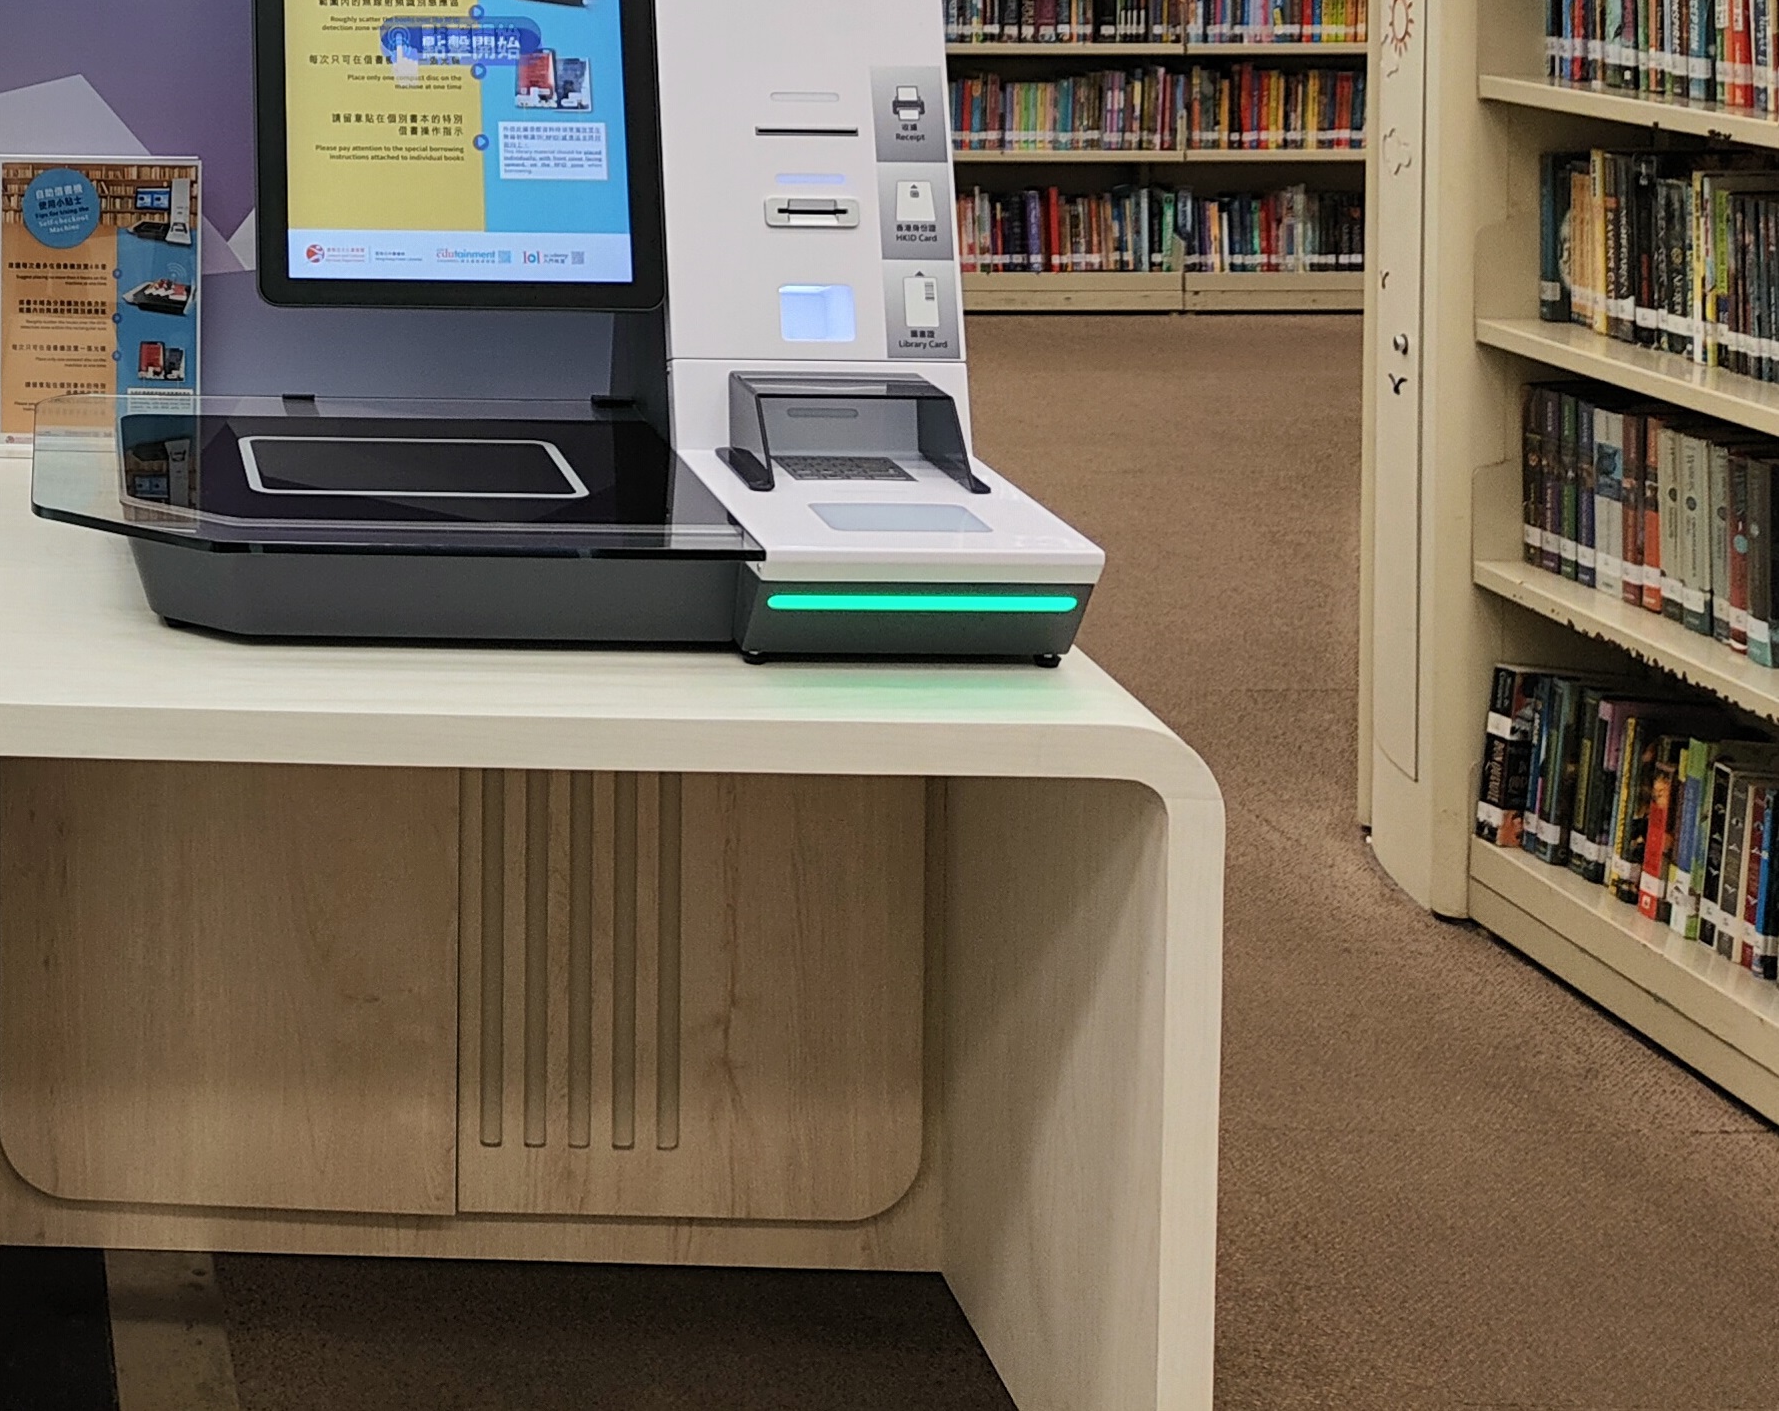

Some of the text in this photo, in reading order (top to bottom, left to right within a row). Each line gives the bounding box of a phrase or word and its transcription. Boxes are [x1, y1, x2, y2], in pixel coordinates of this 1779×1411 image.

[895, 133, 925, 142] Receipt
[896, 224, 937, 232] 香港身份證
[896, 234, 938, 242] HKID Card
[898, 340, 948, 350] Library Card
